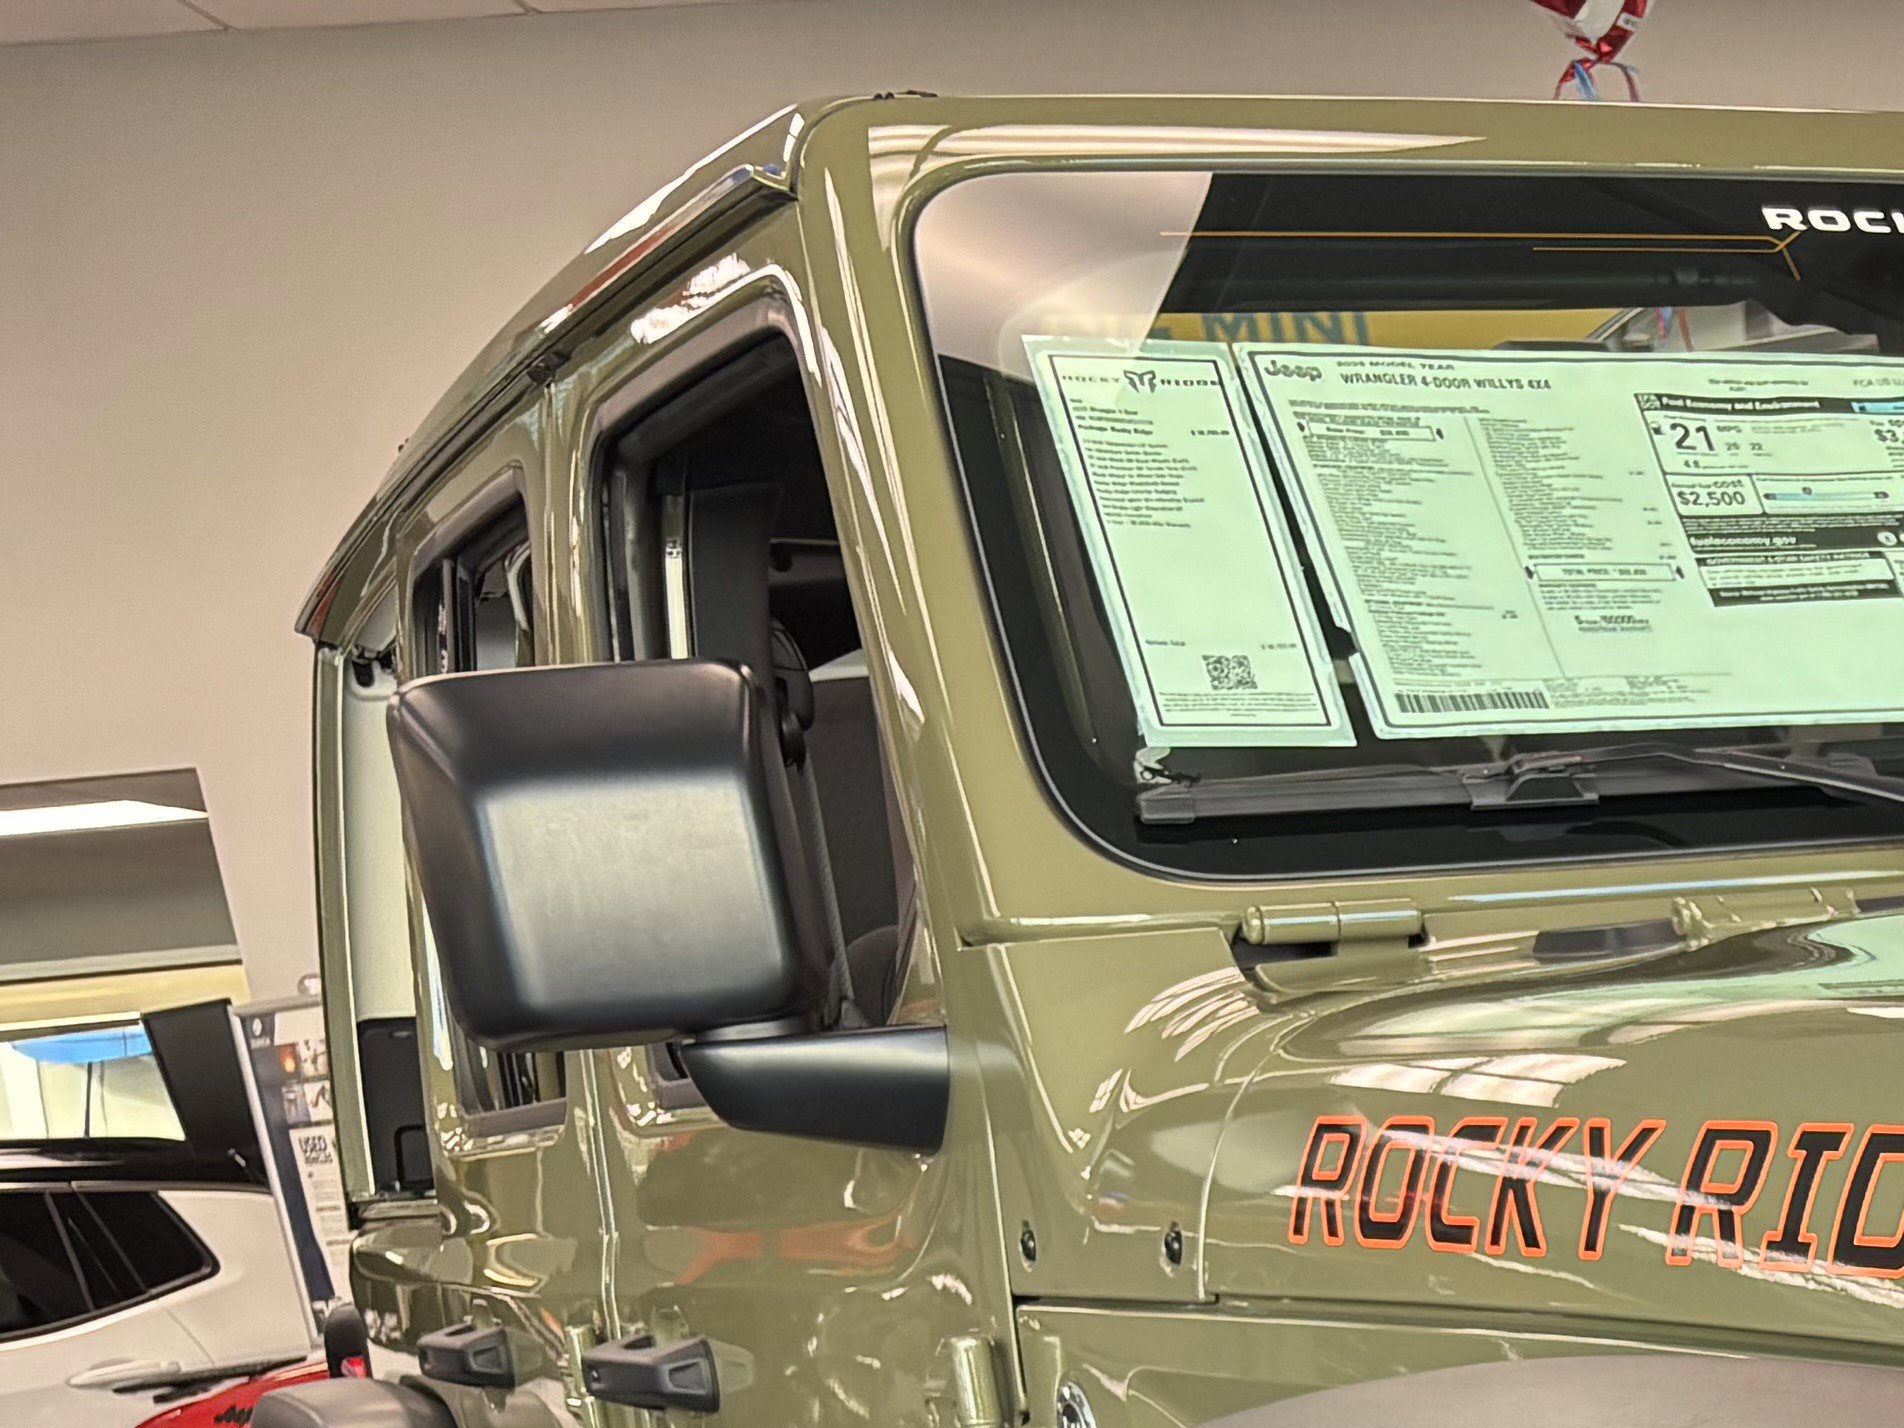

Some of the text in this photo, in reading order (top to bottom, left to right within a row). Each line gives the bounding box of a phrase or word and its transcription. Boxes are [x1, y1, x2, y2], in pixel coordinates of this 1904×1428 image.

[1340, 372, 1417, 386] WRANGLER
[1669, 422, 1715, 451] 21
[1676, 489, 1747, 507] $2,500
[1287, 1114, 1667, 1260] ROCKY
